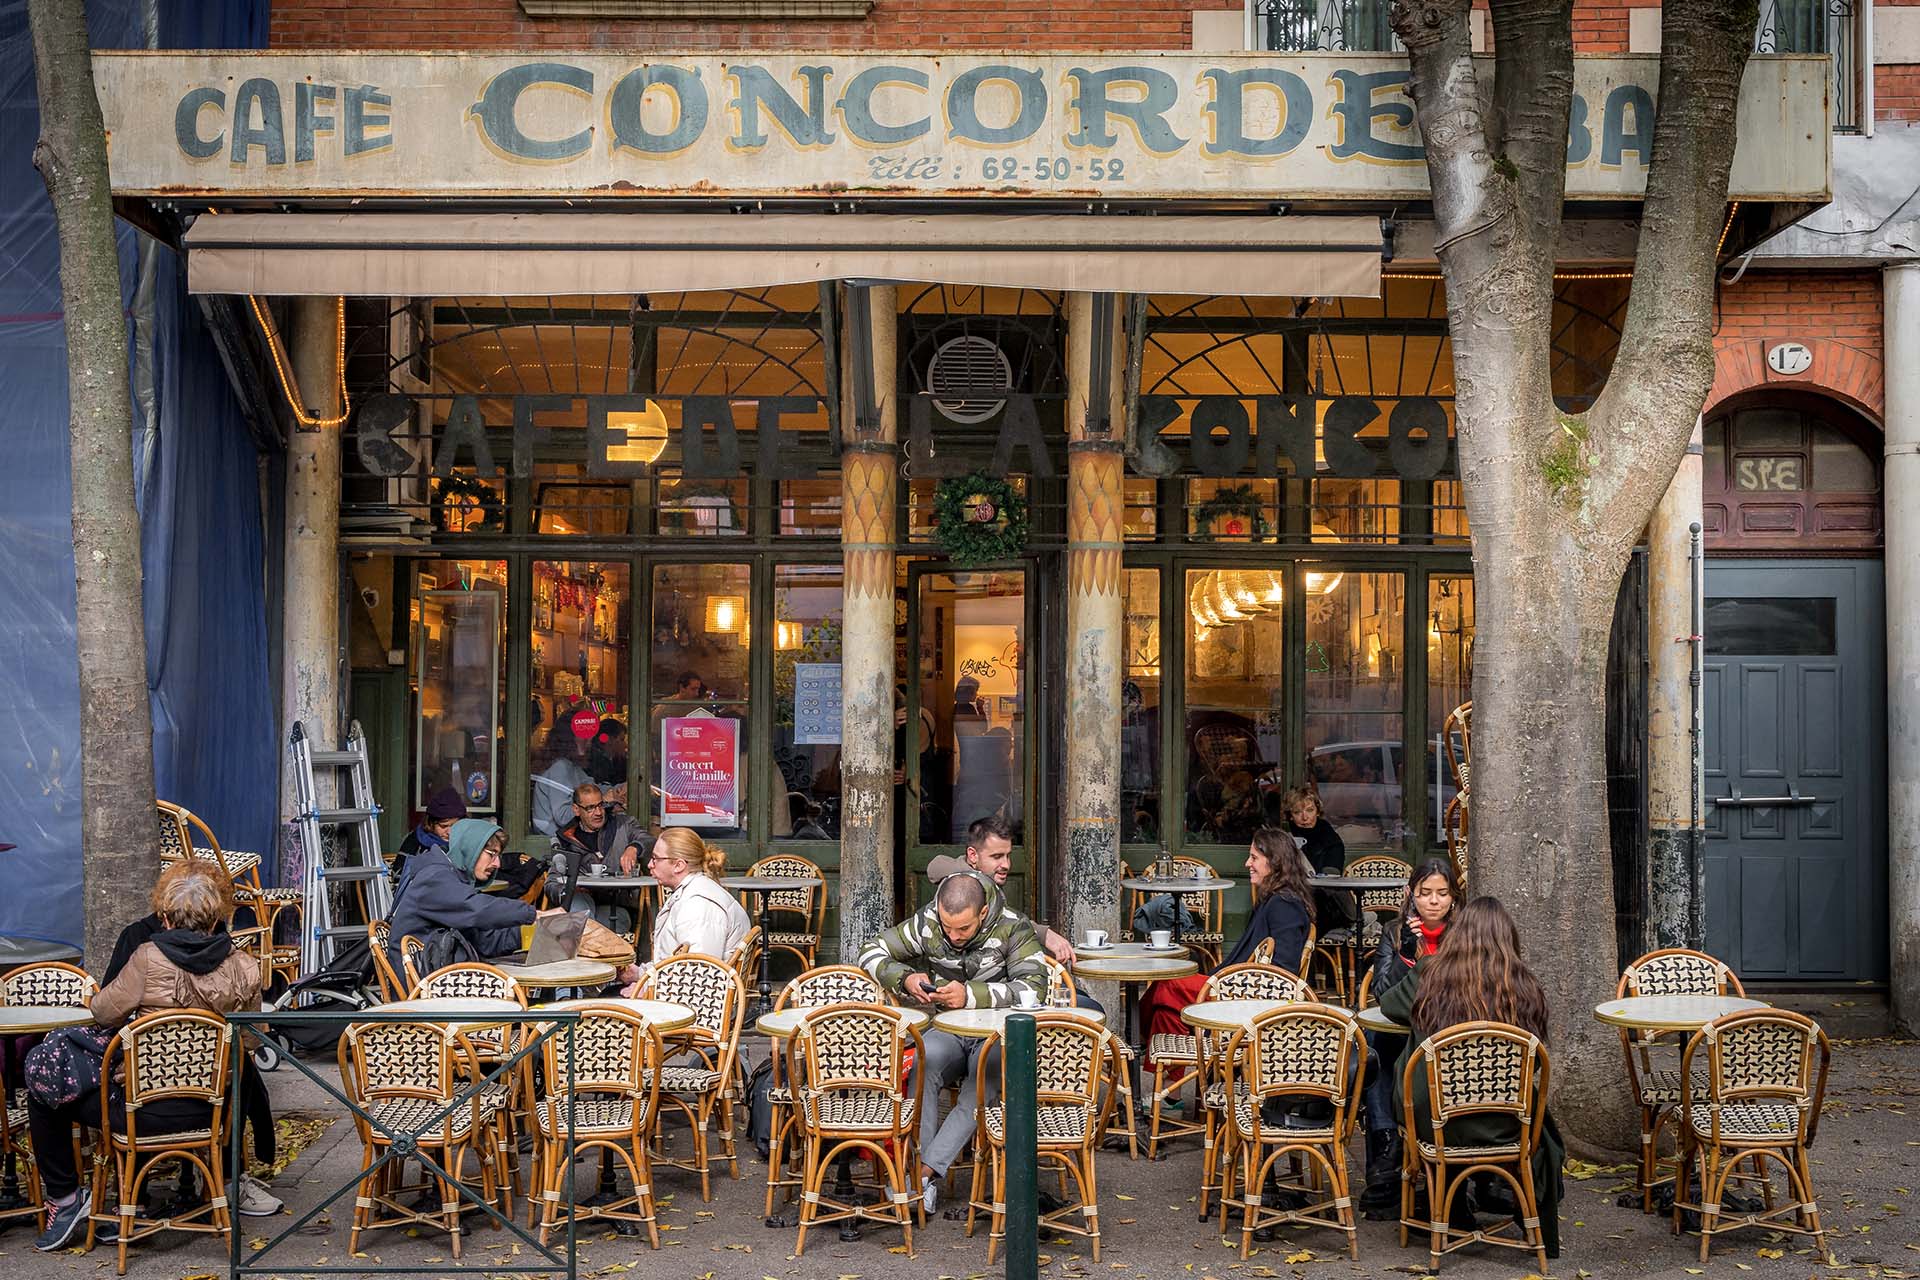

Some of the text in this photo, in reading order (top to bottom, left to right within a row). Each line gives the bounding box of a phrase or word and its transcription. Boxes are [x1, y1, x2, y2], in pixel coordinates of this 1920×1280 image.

[466, 62, 1427, 164] CONCORDE
[982, 157, 1124, 181] 62-50-52
[1778, 347, 1804, 369] 17
[357, 396, 646, 478] CAFE
[910, 396, 1055, 479] LA
[669, 759, 713, 770] Concert
[693, 770, 731, 781] famille
